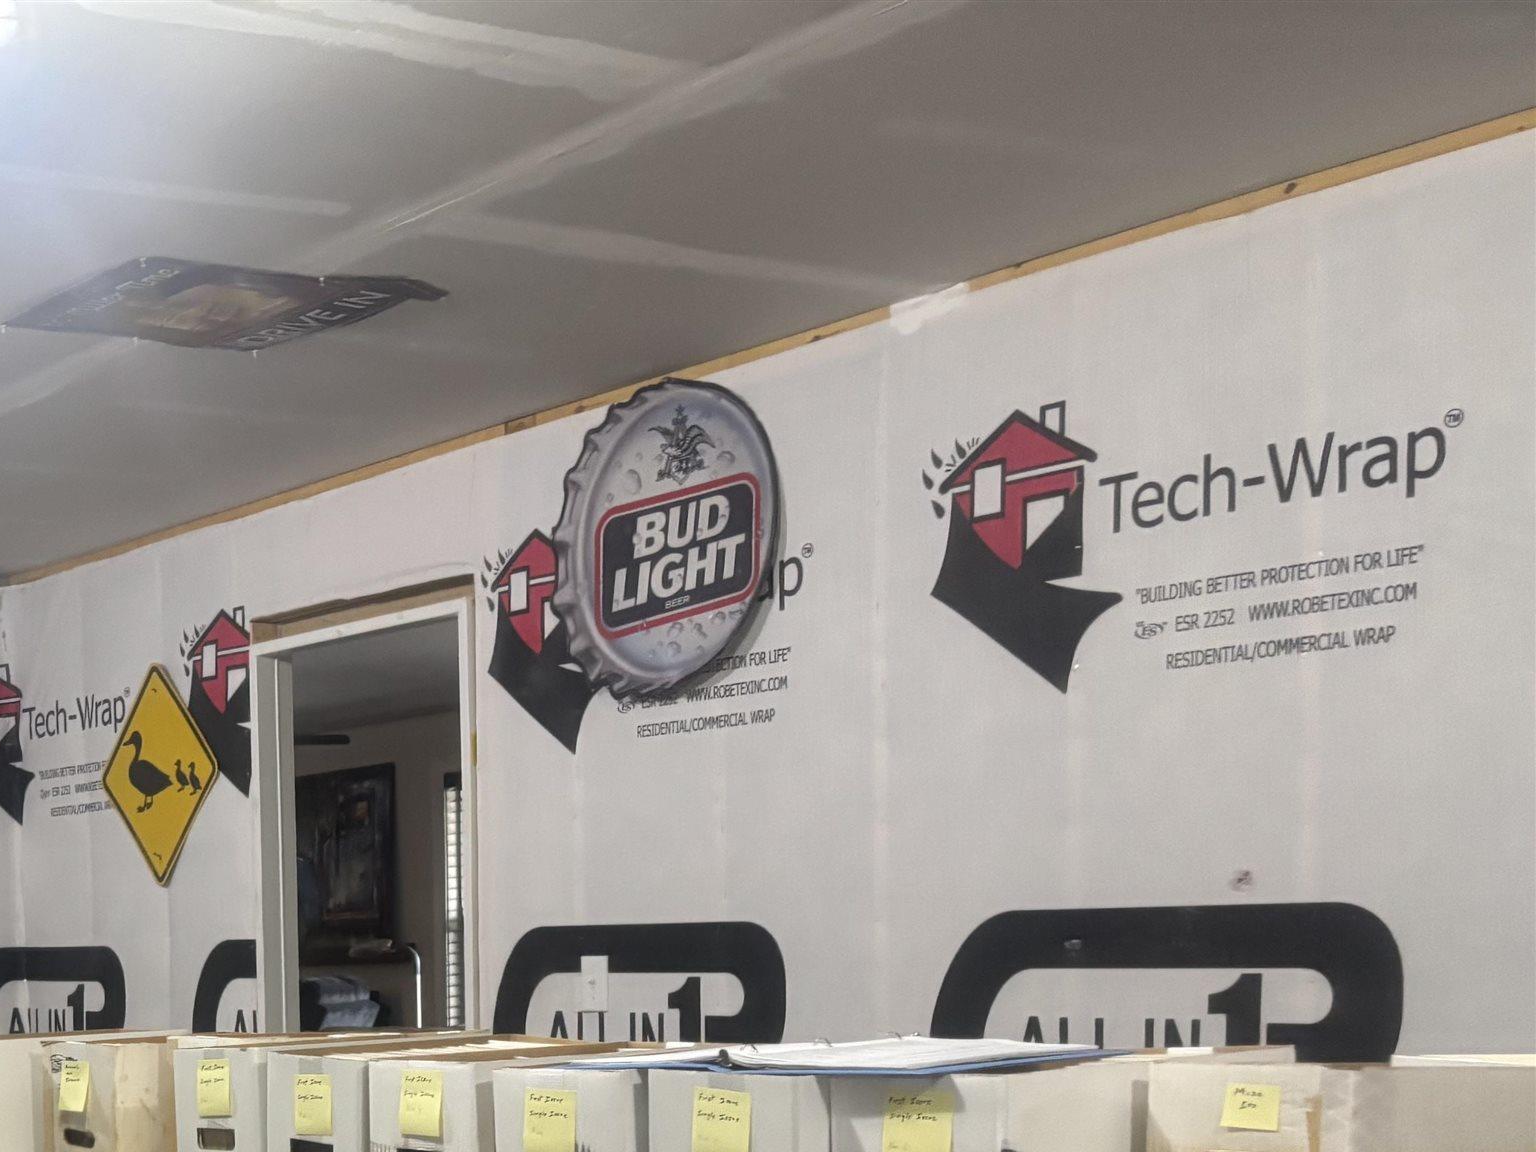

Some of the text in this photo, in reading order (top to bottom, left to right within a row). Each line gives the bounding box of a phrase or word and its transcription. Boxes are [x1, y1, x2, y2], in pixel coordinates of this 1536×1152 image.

[238, 290, 391, 343] DRIVE IN
[1098, 426, 1446, 533] Tech-Wrap
[632, 494, 730, 559] BUD
[611, 533, 746, 612] LIGHT
[1206, 571, 1257, 594] BETTER
[1261, 556, 1349, 585] PROTECTION
[1354, 552, 1383, 572] FOR
[665, 596, 690, 609] BEER
[1175, 613, 1200, 632] ESR
[1203, 608, 1235, 628] 2252
[1248, 582, 1417, 622] WWW.ROBETEXINC.COM
[749, 652, 766, 667] FOR
[1166, 625, 1396, 669] RESIDENTIAL/COMMERCIAL WRAP
[23, 694, 125, 740] Tech-Wrap
[637, 708, 775, 738] RESIDENTIAL/COMMERCIAL WRAP
